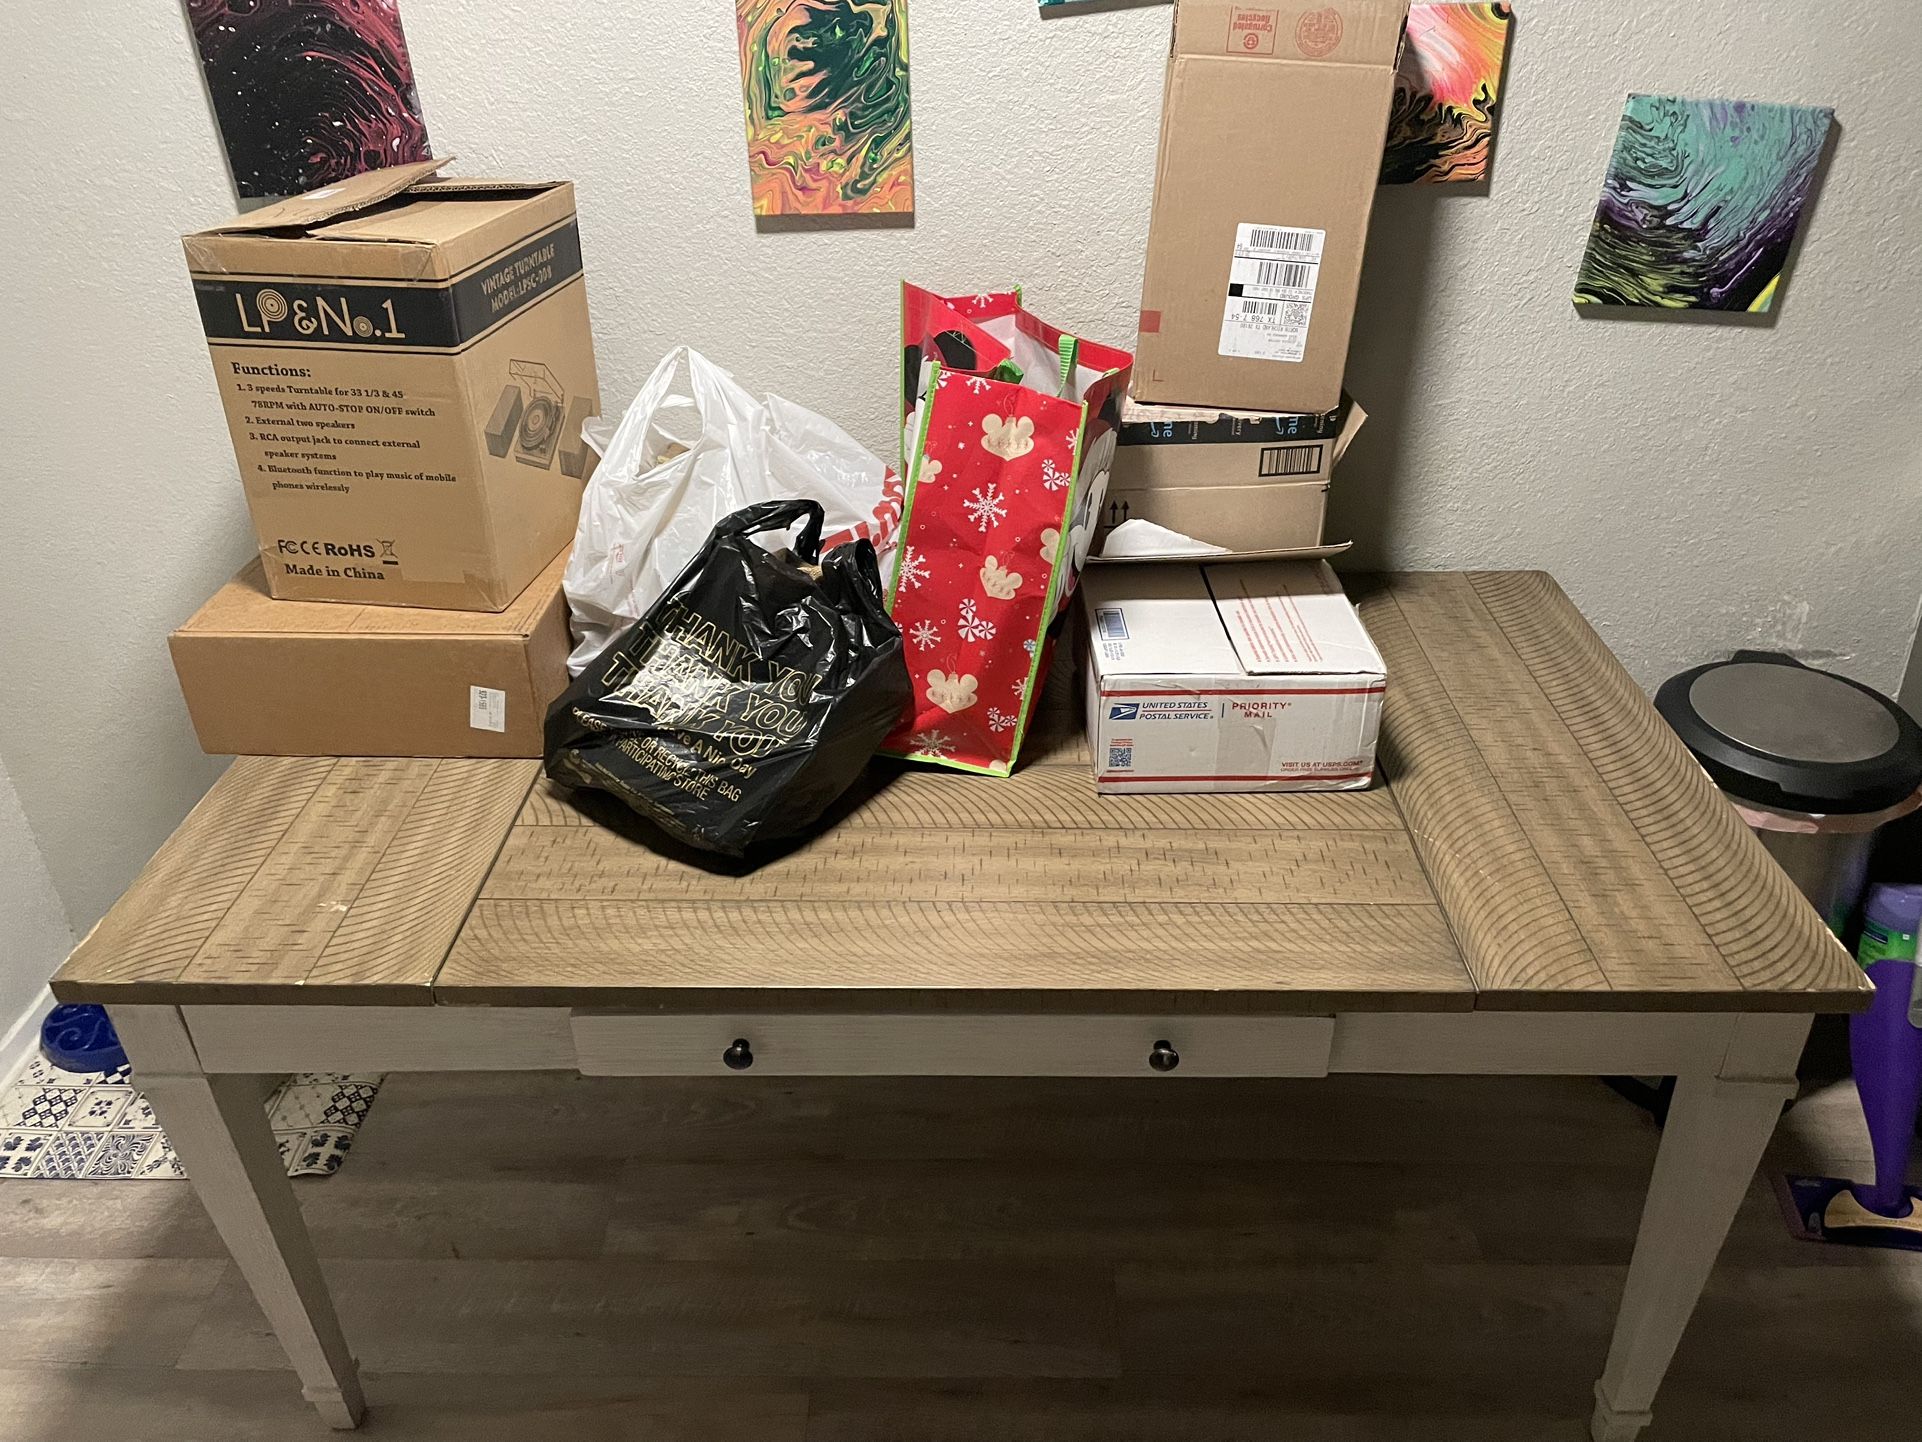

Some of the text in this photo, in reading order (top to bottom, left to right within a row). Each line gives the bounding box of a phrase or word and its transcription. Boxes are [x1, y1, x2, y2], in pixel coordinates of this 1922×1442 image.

[481, 243, 555, 296] VINTAGE TURNTABLE
[231, 362, 311, 377] Functions:
[255, 384, 285, 394] speeds
[287, 386, 333, 396] Turntable
[335, 388, 349, 396] for
[351, 389, 363, 397] 33
[364, 389, 380, 398] 1/3
[382, 390, 390, 398] &
[392, 391, 403, 399] 45
[251, 401, 435, 417] 78RPM with AUTO-STOP ON/OFF switch
[245, 416, 355, 431] 2. External two speakers
[249, 433, 420, 449] 3. RCA output jack to connect external
[265, 450, 337, 462] speaker systems
[268, 465, 312, 475] Bluetooth
[314, 466, 352, 477] function
[353, 469, 364, 477] to
[366, 470, 384, 481] play
[386, 471, 413, 480] music
[414, 472, 424, 481] of
[425, 473, 457, 482] mobile
[272, 481, 350, 494] phones wirelessly
[324, 542, 376, 558] RoHS
[284, 563, 385, 580] Made in China
[656, 603, 823, 705] THANK YOU
[629, 620, 807, 738] THANK YOU
[1178, 701, 1208, 709] STATES
[1232, 702, 1288, 710] PRIORITY
[695, 740, 703, 754] A
[714, 720, 783, 758] YOU
[641, 736, 658, 754] OR
[694, 768, 718, 788] THIS
[718, 780, 742, 802] BAG
[673, 773, 711, 801] STORE
